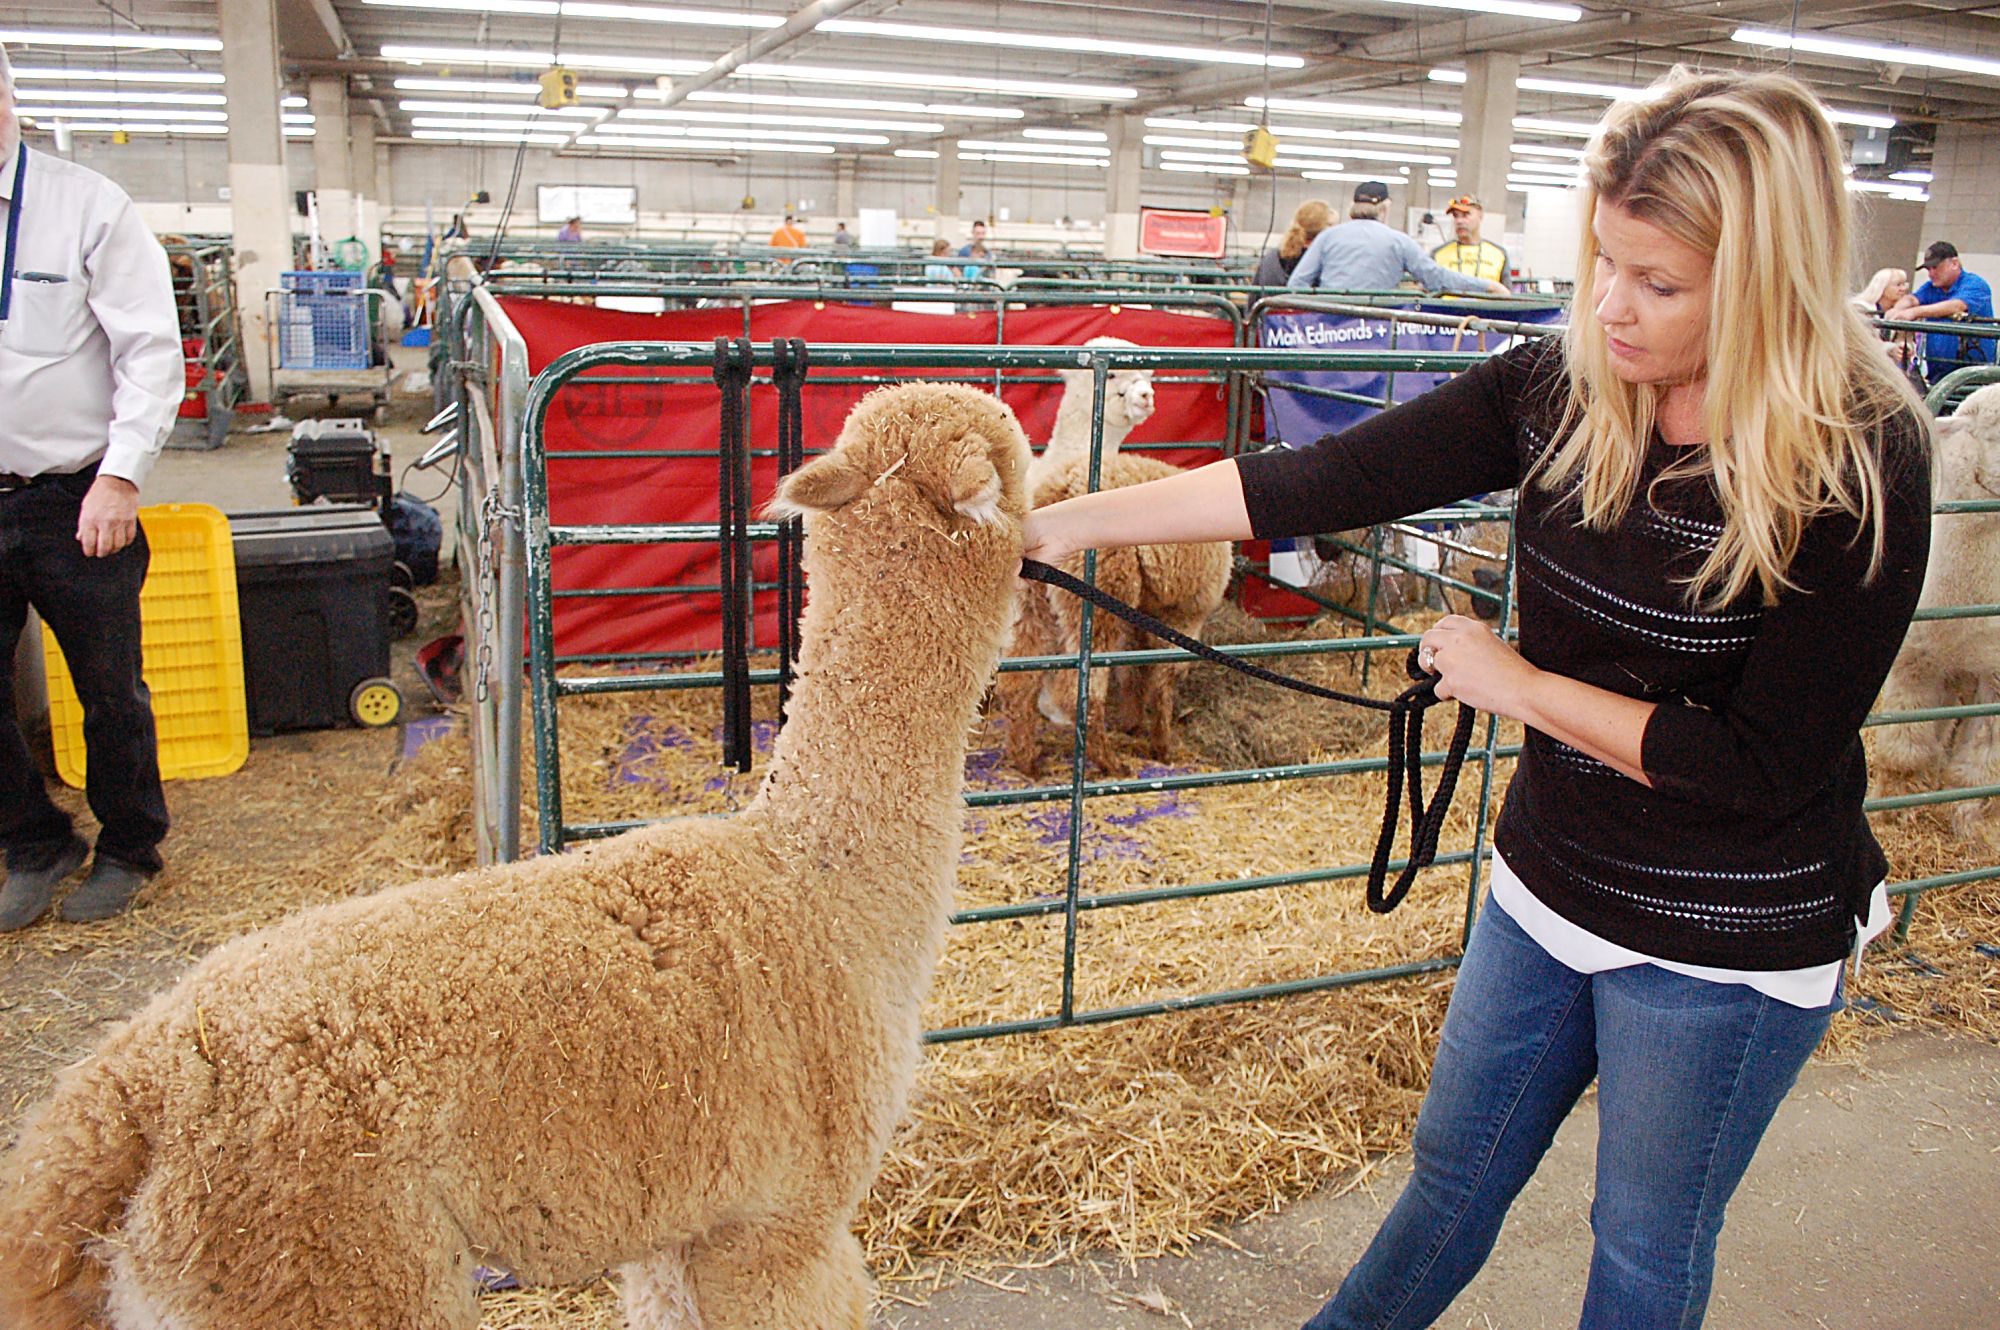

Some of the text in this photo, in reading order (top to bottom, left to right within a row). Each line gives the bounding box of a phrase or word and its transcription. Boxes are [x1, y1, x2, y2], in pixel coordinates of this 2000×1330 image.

[1267, 325, 1303, 346] Mark
[1305, 319, 1373, 344] Edmonds
[1376, 325, 1387, 337] +
